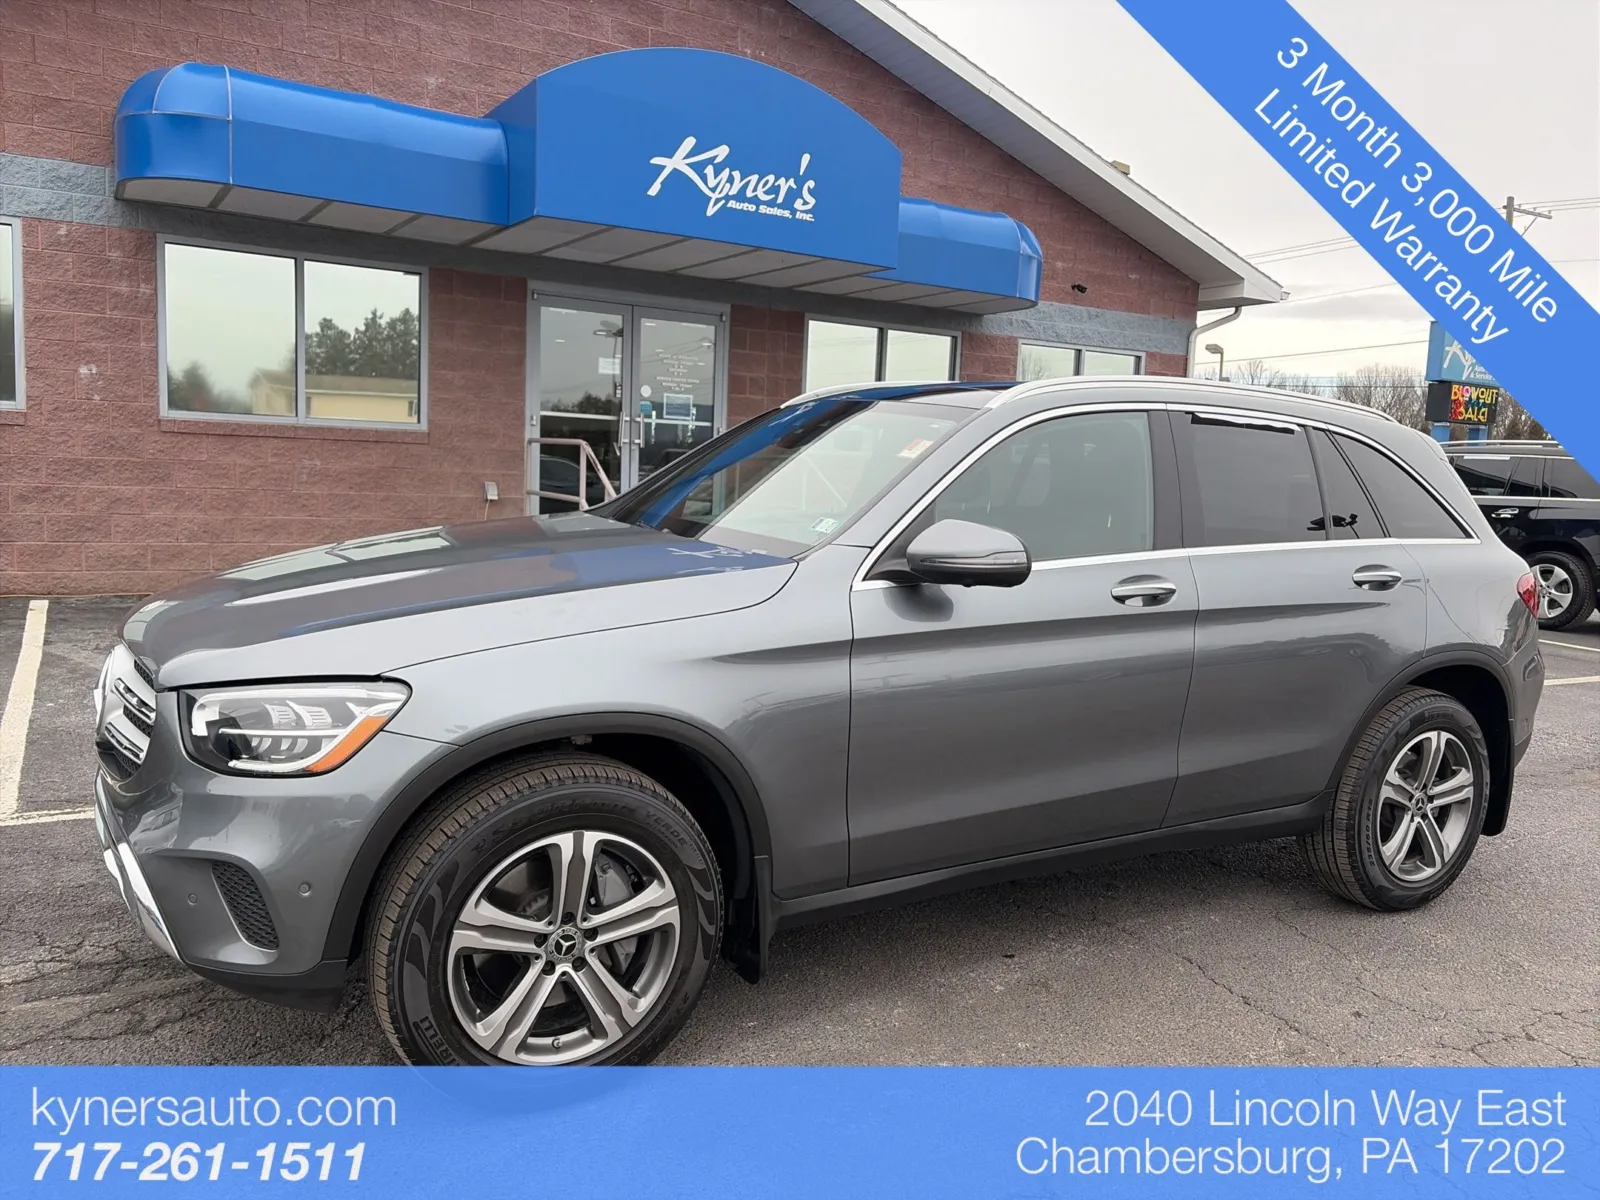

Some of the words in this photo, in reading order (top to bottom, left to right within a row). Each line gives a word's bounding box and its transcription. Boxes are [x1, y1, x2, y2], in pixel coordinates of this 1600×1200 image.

[647, 136, 816, 216] Kyner's
[727, 200, 756, 212] Auto
[758, 205, 792, 219] Sales,
[795, 210, 815, 221] Inc.
[1451, 384, 1499, 404] BLOWOUT
